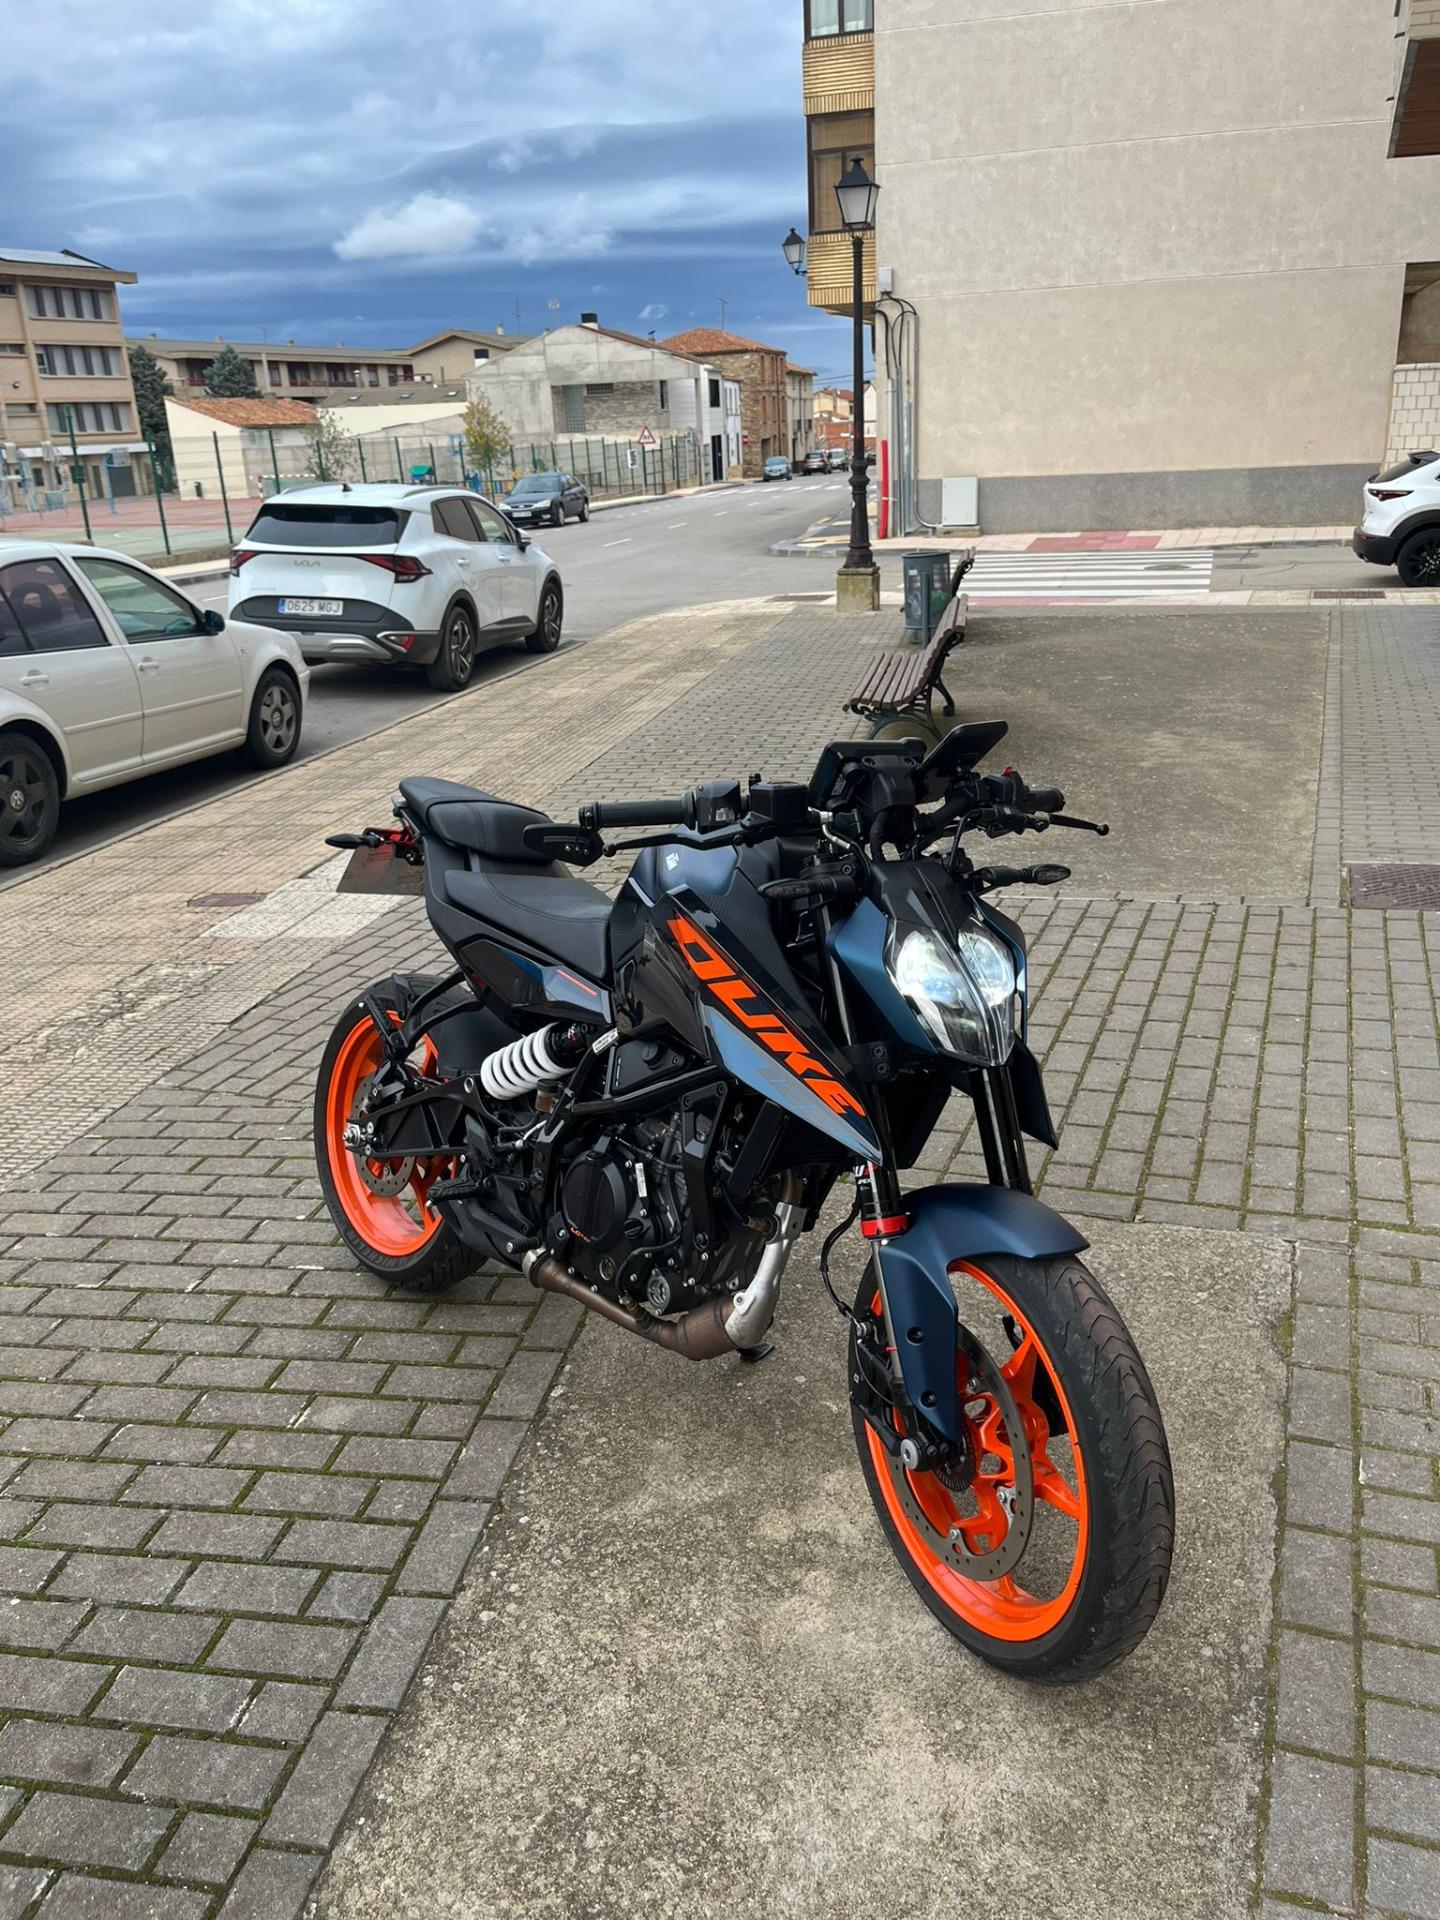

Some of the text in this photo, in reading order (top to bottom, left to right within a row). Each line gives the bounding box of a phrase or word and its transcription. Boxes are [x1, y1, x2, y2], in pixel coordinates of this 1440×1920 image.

[287, 600, 341, 613] 0625 MGJ
[666, 913, 866, 1117] DUKE
